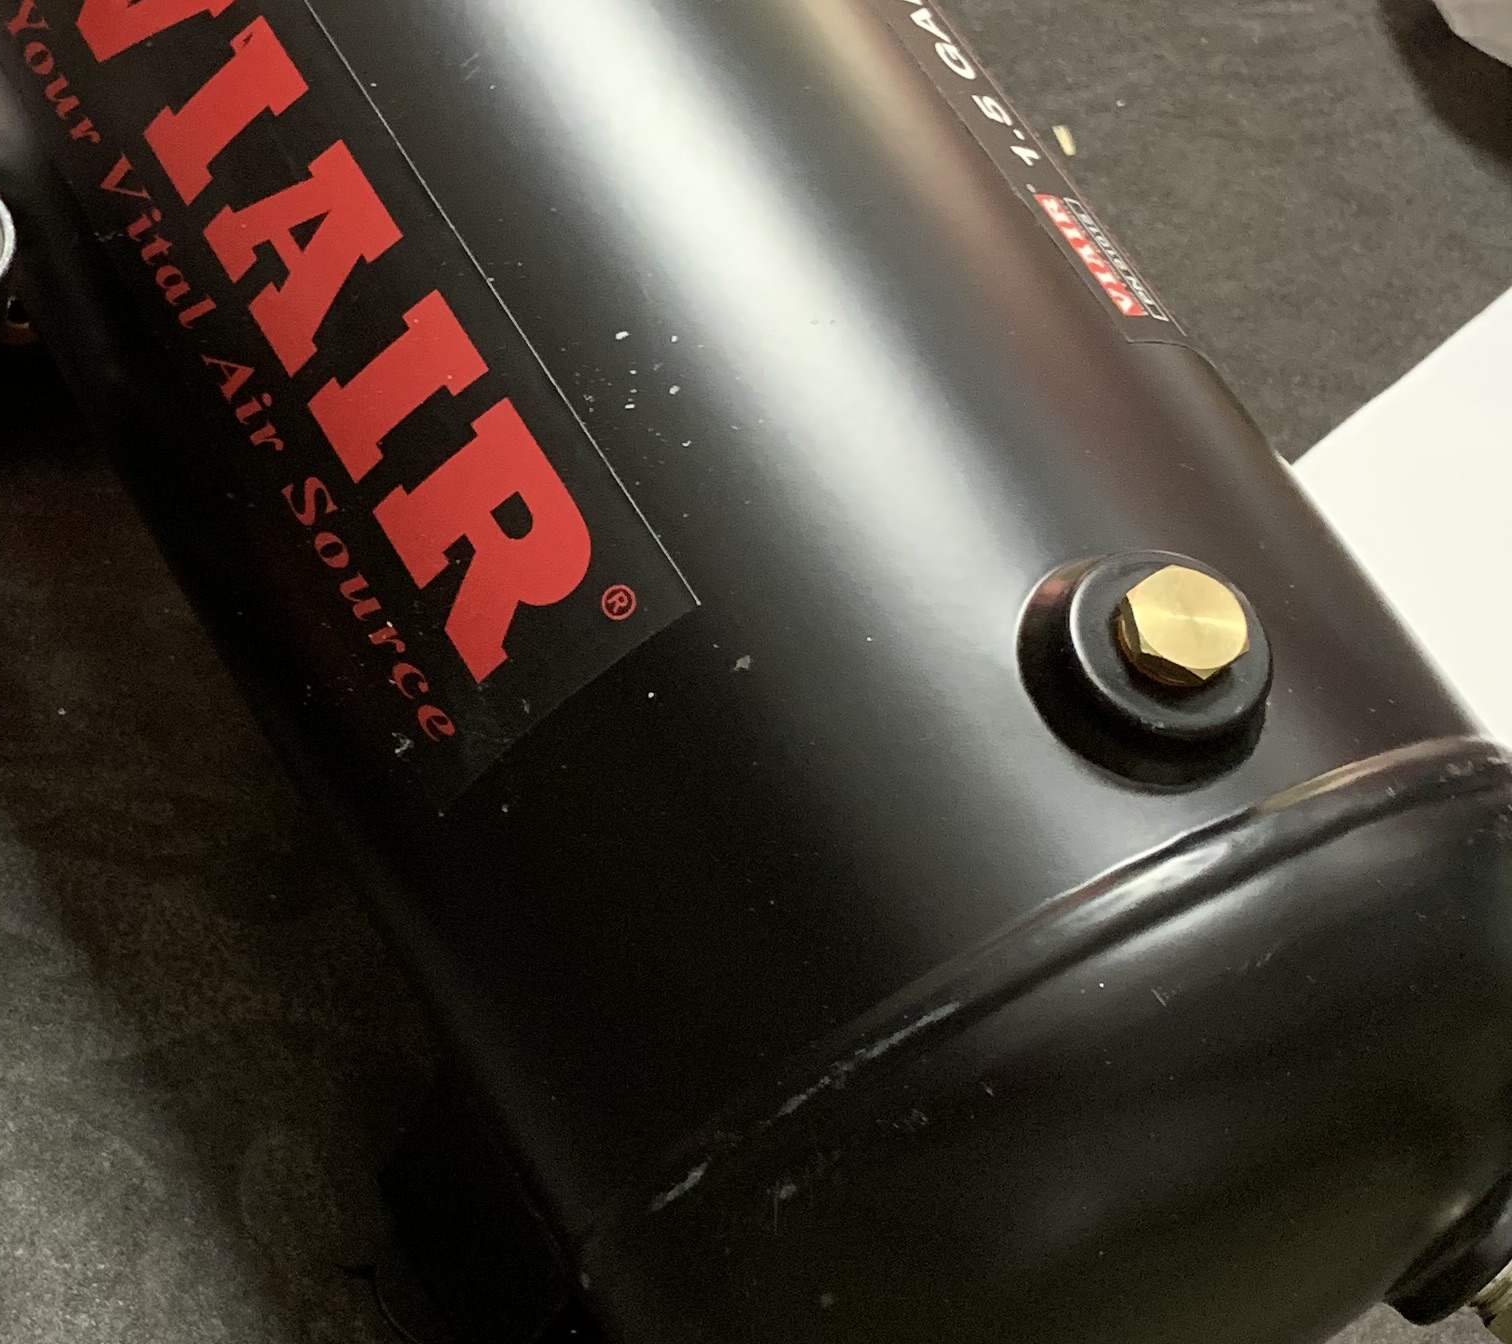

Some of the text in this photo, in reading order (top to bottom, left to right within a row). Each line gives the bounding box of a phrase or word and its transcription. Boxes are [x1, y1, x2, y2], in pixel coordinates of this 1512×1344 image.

[971, 95, 1039, 166] 1.5
[1041, 198, 1133, 313] VIAIR
[100, 155, 217, 330] Vital
[202, 353, 284, 452] Air
[281, 476, 457, 743] Source
